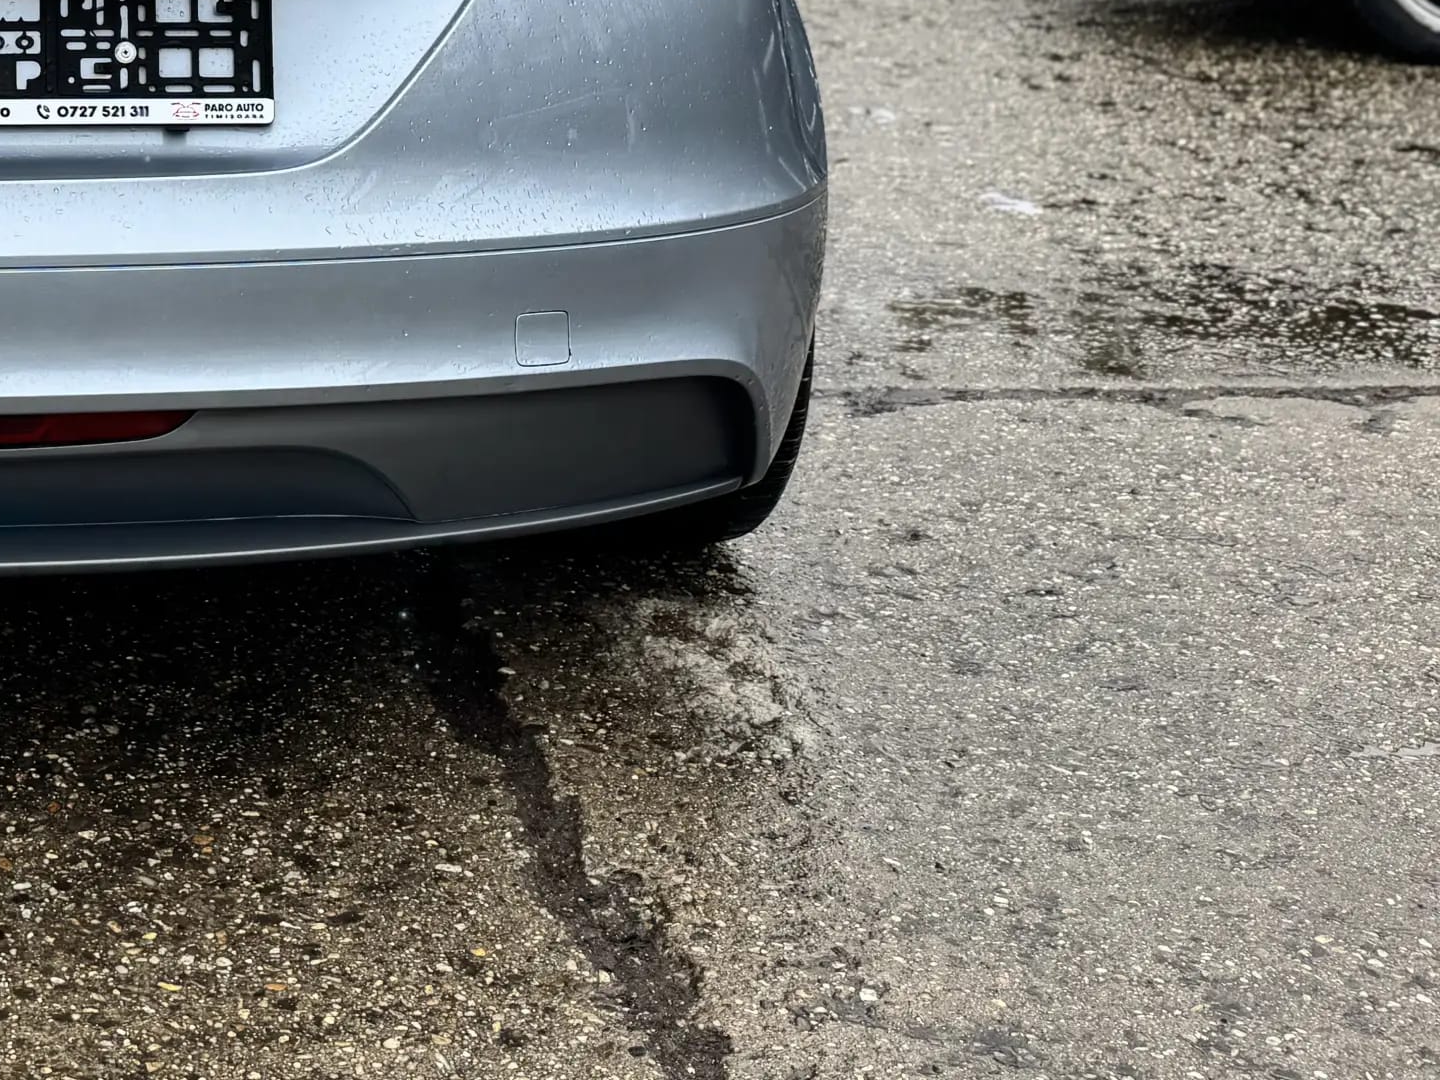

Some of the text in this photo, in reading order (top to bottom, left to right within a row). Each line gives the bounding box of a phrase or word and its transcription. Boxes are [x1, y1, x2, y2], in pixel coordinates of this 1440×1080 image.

[56, 105, 149, 118] 0727 521 311
[235, 103, 264, 112] AUTO
